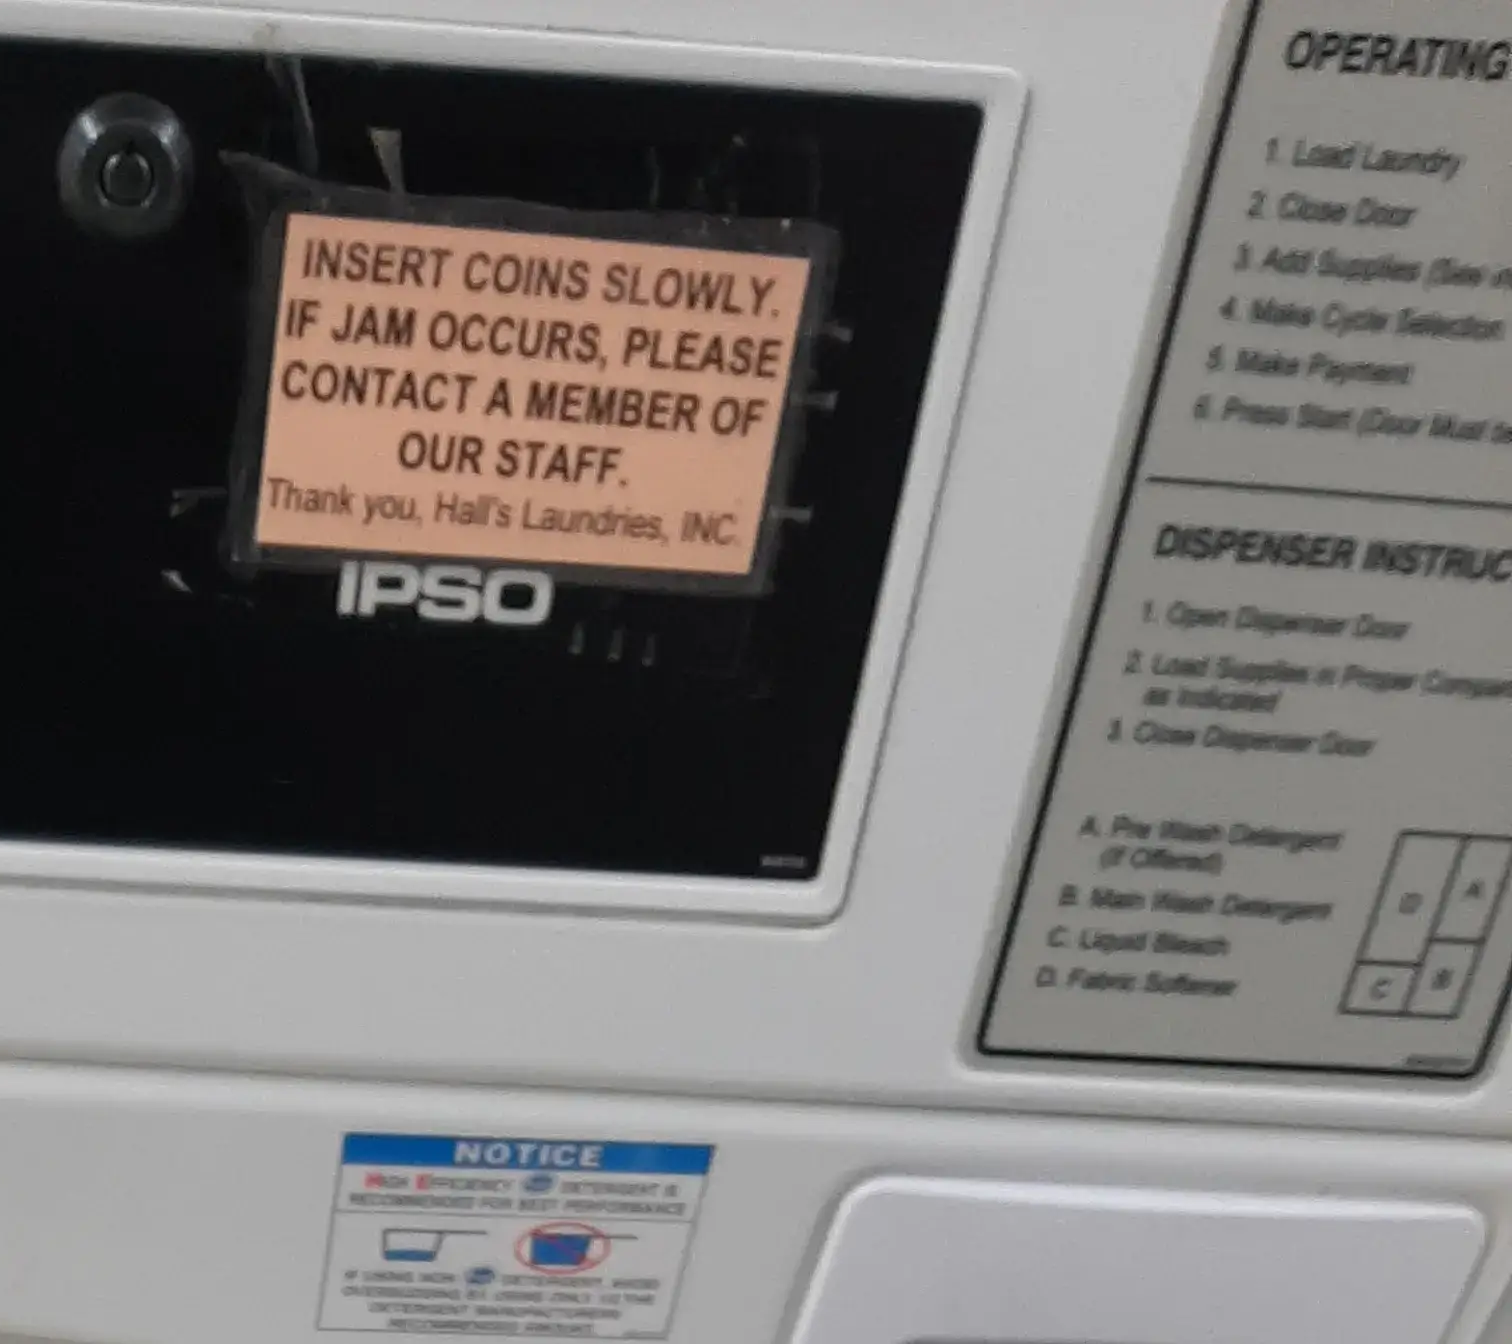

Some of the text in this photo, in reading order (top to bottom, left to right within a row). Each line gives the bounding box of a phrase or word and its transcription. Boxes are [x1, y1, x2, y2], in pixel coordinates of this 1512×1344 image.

[1285, 31, 1512, 80] OPERATING
[302, 238, 782, 319] INSERT COINS SLOWLY.
[284, 298, 783, 380] IF JAM OCCURS, PLEASE
[279, 361, 767, 438] CONTACT A MEMBER OF
[397, 430, 629, 488] OUR STAFF.
[267, 477, 352, 516] Thank
[361, 490, 424, 527] you,
[1155, 523, 1357, 571] DISPENSER
[336, 560, 554, 626] IPSO
[453, 1140, 604, 1169] NOTICE
